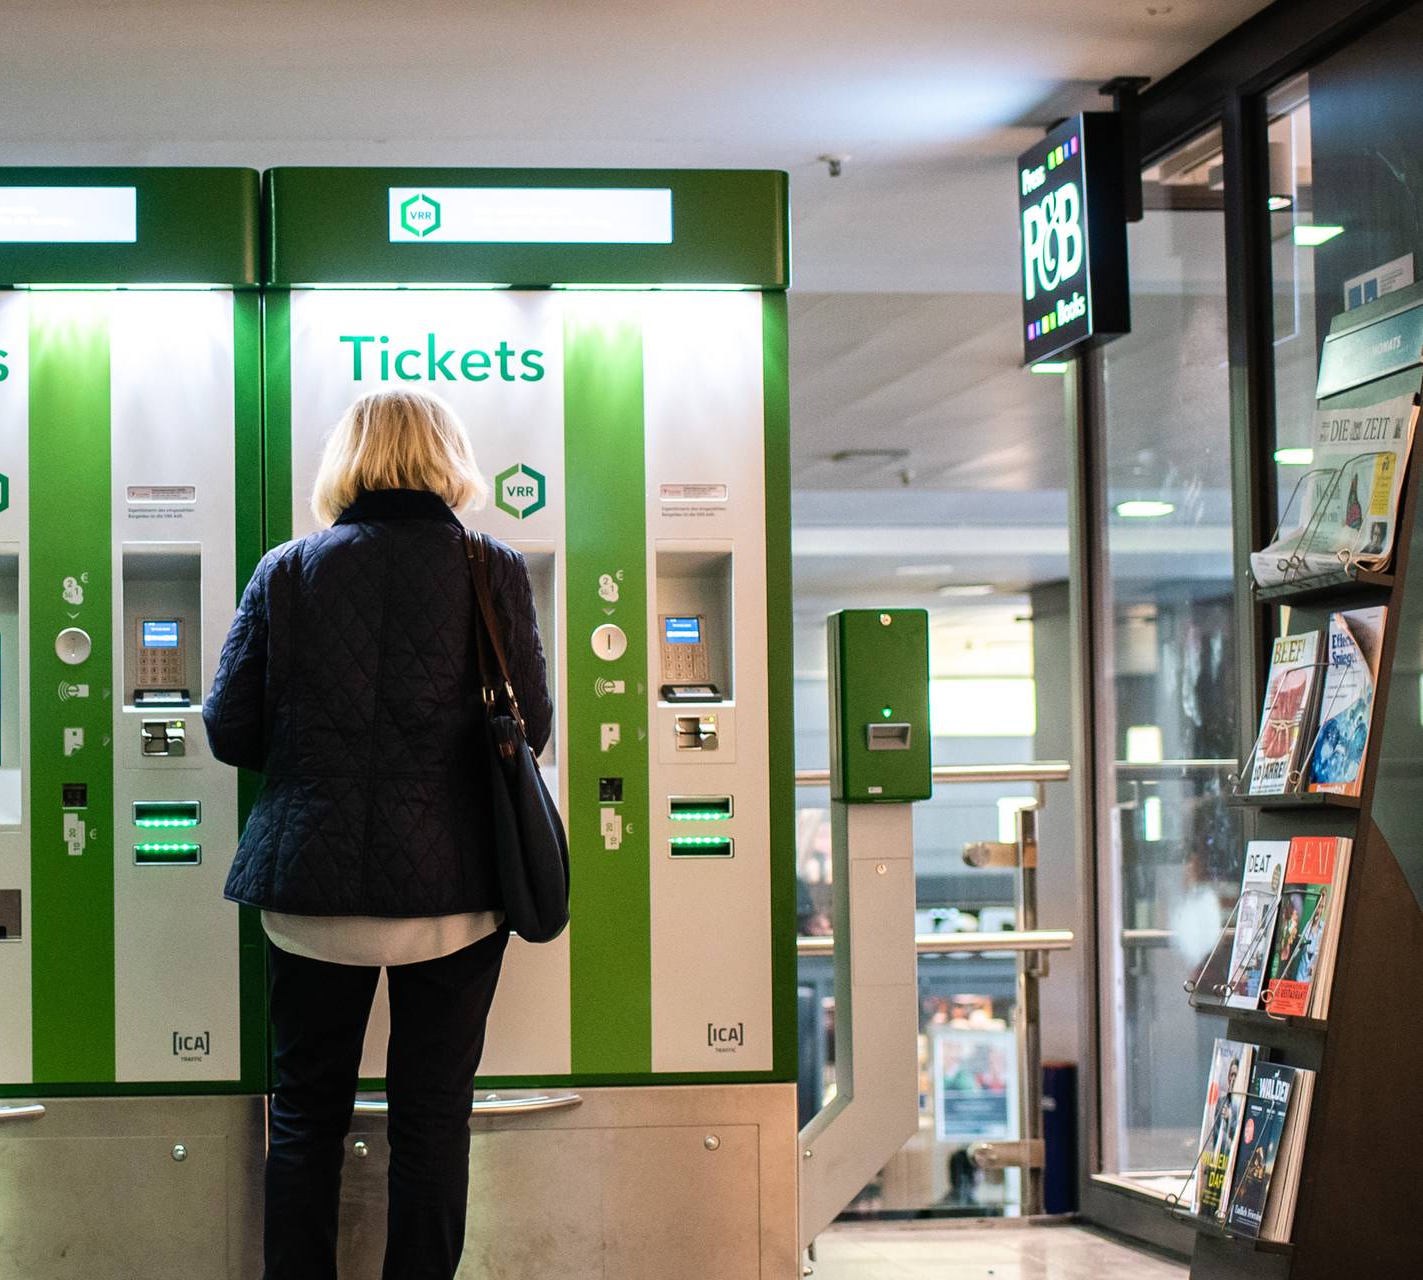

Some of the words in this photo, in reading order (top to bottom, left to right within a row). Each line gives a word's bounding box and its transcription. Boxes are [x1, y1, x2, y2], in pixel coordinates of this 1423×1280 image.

[410, 211, 432, 220] VRR
[339, 333, 545, 383] Tickets
[1330, 419, 1350, 442] DIE
[1363, 416, 1391, 441] ZEIT
[506, 486, 534, 498] VRR
